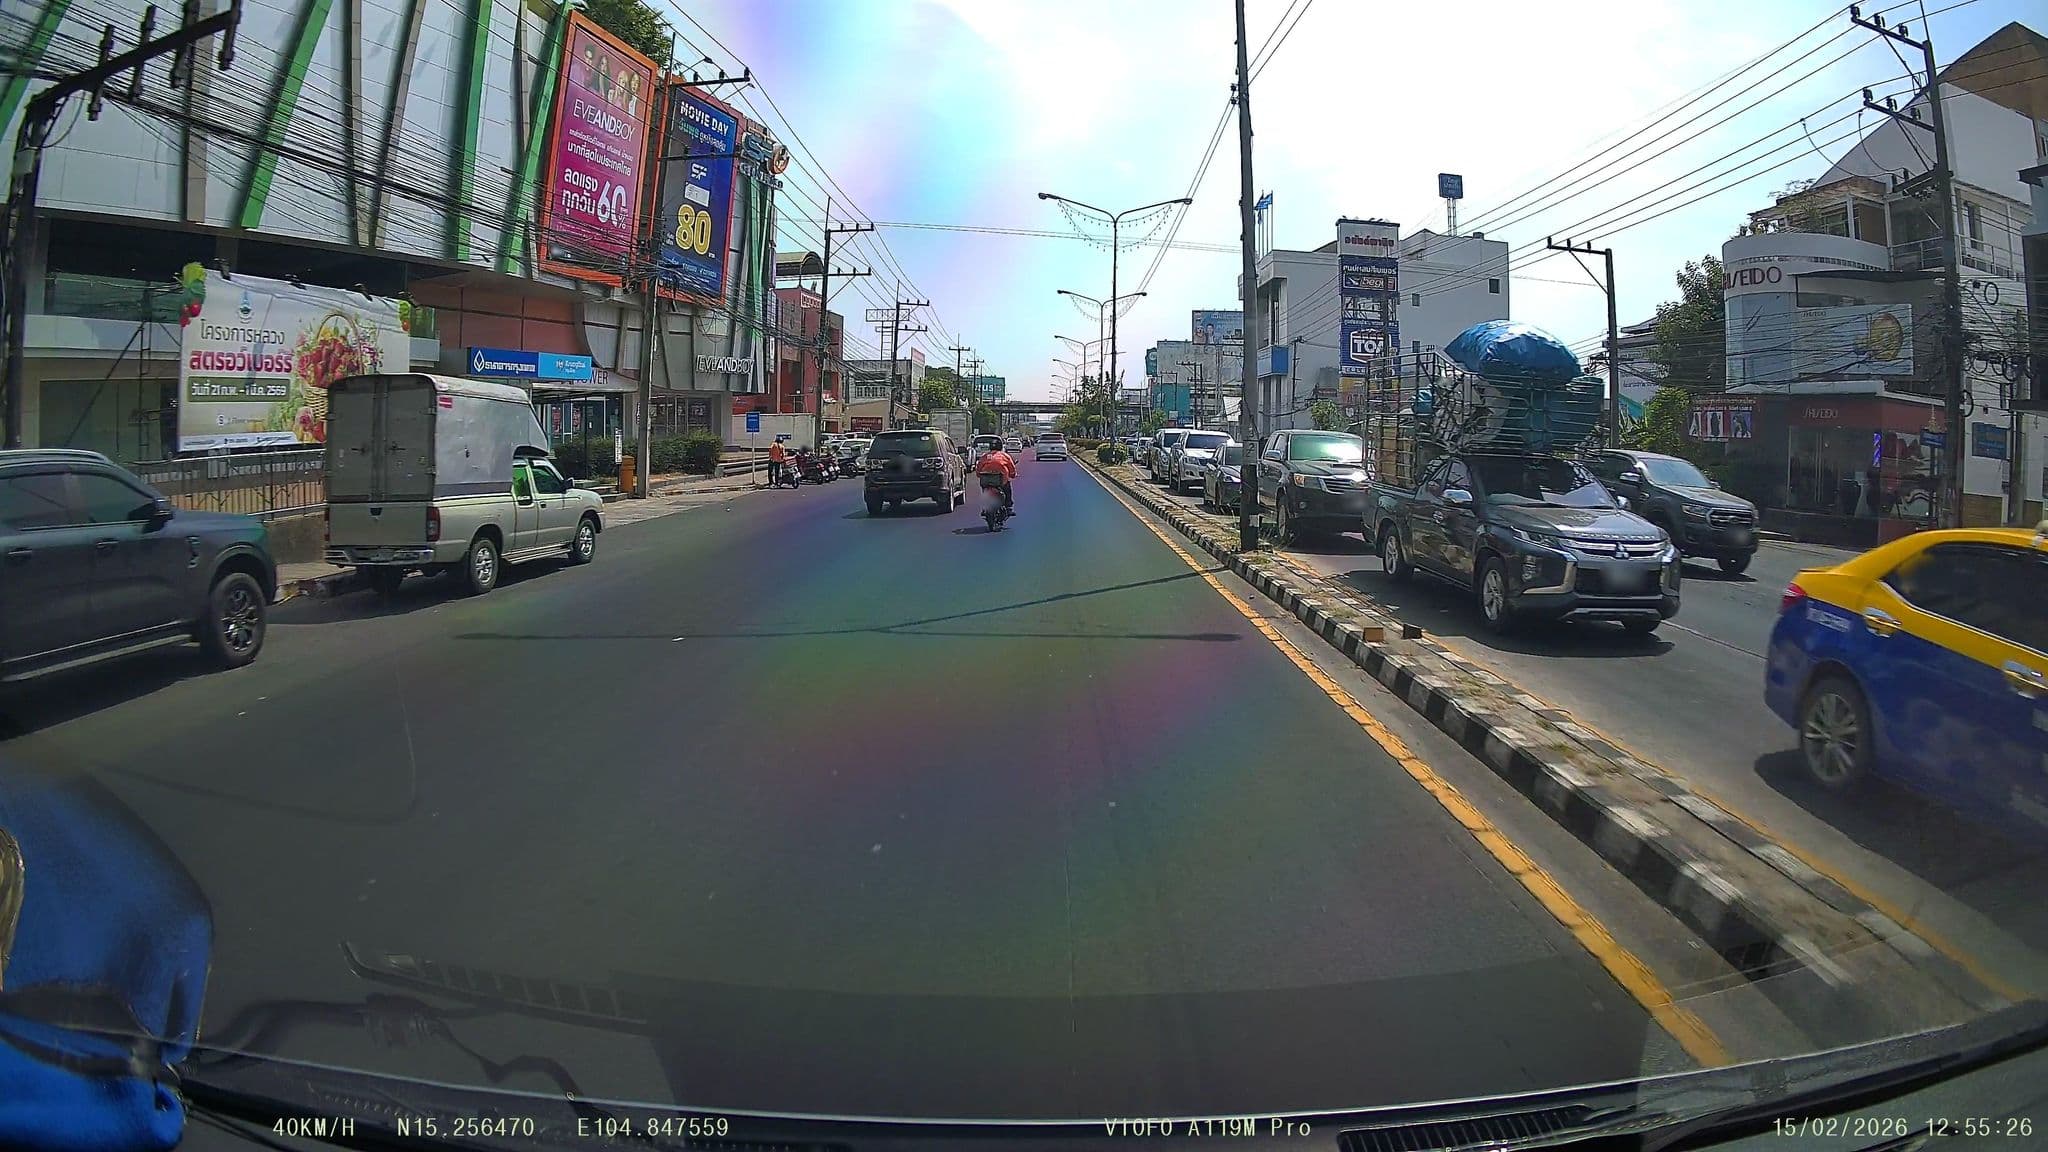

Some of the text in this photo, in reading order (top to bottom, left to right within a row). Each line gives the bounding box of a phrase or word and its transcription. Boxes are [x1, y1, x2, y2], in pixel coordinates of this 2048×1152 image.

[573, 99, 635, 142] EVEANDBOY
[680, 101, 729, 137] MOVIE DAY
[567, 140, 632, 177] มากที่สุดในประเทศไทย
[564, 168, 599, 193] ลดแรง
[562, 188, 596, 215] ทุกวัน
[676, 204, 711, 255] 80
[200, 318, 286, 344] โครงการหลวง
[696, 355, 754, 374] EVEANDBOY
